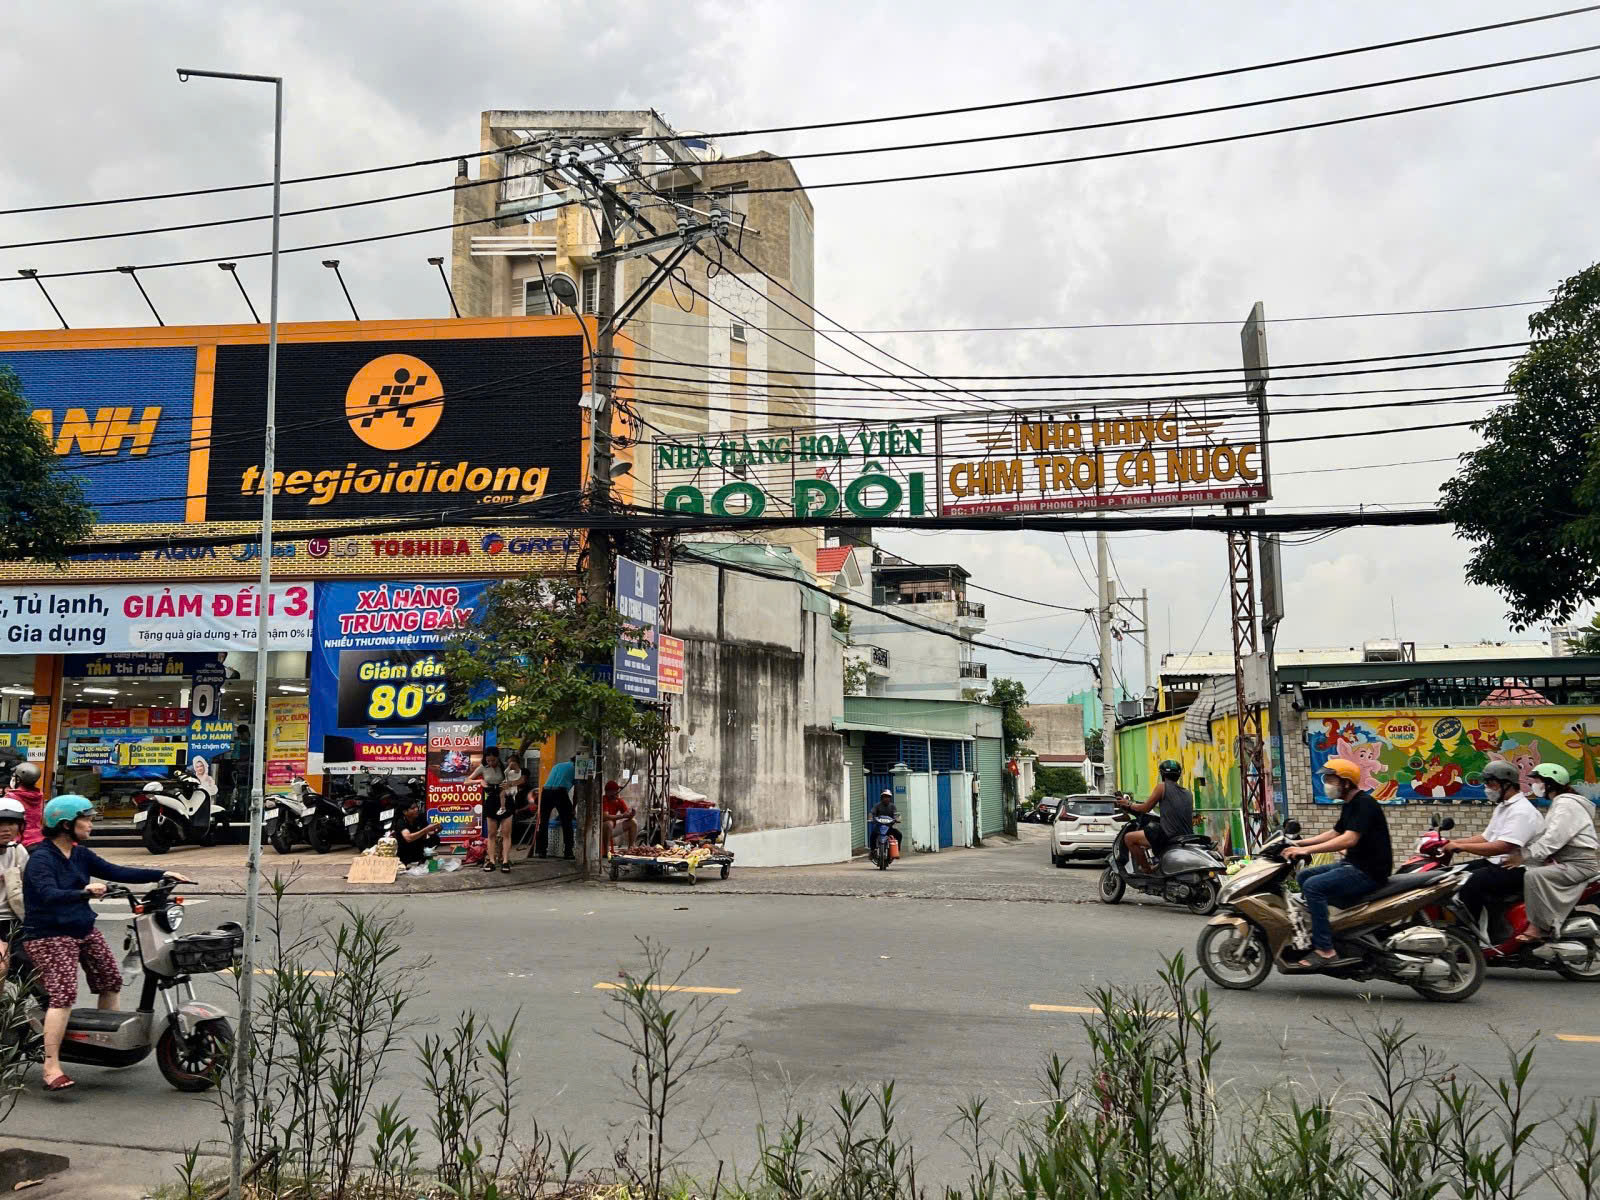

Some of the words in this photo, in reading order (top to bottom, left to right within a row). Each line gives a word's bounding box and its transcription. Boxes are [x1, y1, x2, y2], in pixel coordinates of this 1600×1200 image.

[1020, 412, 1082, 451] NHÀ
[1092, 411, 1178, 447] HÀNG
[658, 436, 713, 469] NHÀ
[719, 433, 793, 466] HÀNG
[799, 432, 850, 461] HOA
[858, 424, 924, 456] VIÊN
[949, 457, 1023, 497] CHIM
[476, 494, 513, 504] .com
[1013, 501, 1037, 512] ĐÌNH
[1040, 500, 1074, 510] PHONG
[1252, 490, 1259, 498] 9
[333, 540, 358, 556] LG
[371, 539, 471, 556] TOSHIBA
[13, 593, 42, 614] Tủ
[49, 594, 109, 619] lạnh,
[123, 587, 203, 619] GIẢM
[357, 584, 389, 611] XẢ
[339, 610, 419, 634] TRƯNG
[8, 624, 42, 643] Gia
[48, 624, 106, 646] dụng
[138, 630, 163, 642] Tặng
[186, 630, 202, 641] gia
[204, 629, 230, 641] dụng
[241, 628, 257, 639] Trả
[290, 629, 306, 638] 0%
[354, 637, 395, 648] THƯƠNG
[396, 636, 418, 647] HIỆU
[418, 636, 439, 644] TIVI
[360, 661, 407, 680] Giảm
[411, 656, 447, 678] đến
[368, 684, 446, 719] 80%
[191, 720, 202, 732] 4
[362, 745, 384, 755] BAO
[403, 742, 413, 755] 7
[428, 792, 482, 802] 10.990.000
[429, 784, 454, 793] Smart
[456, 784, 466, 792] TV
[452, 815, 474, 824] QUẠT
